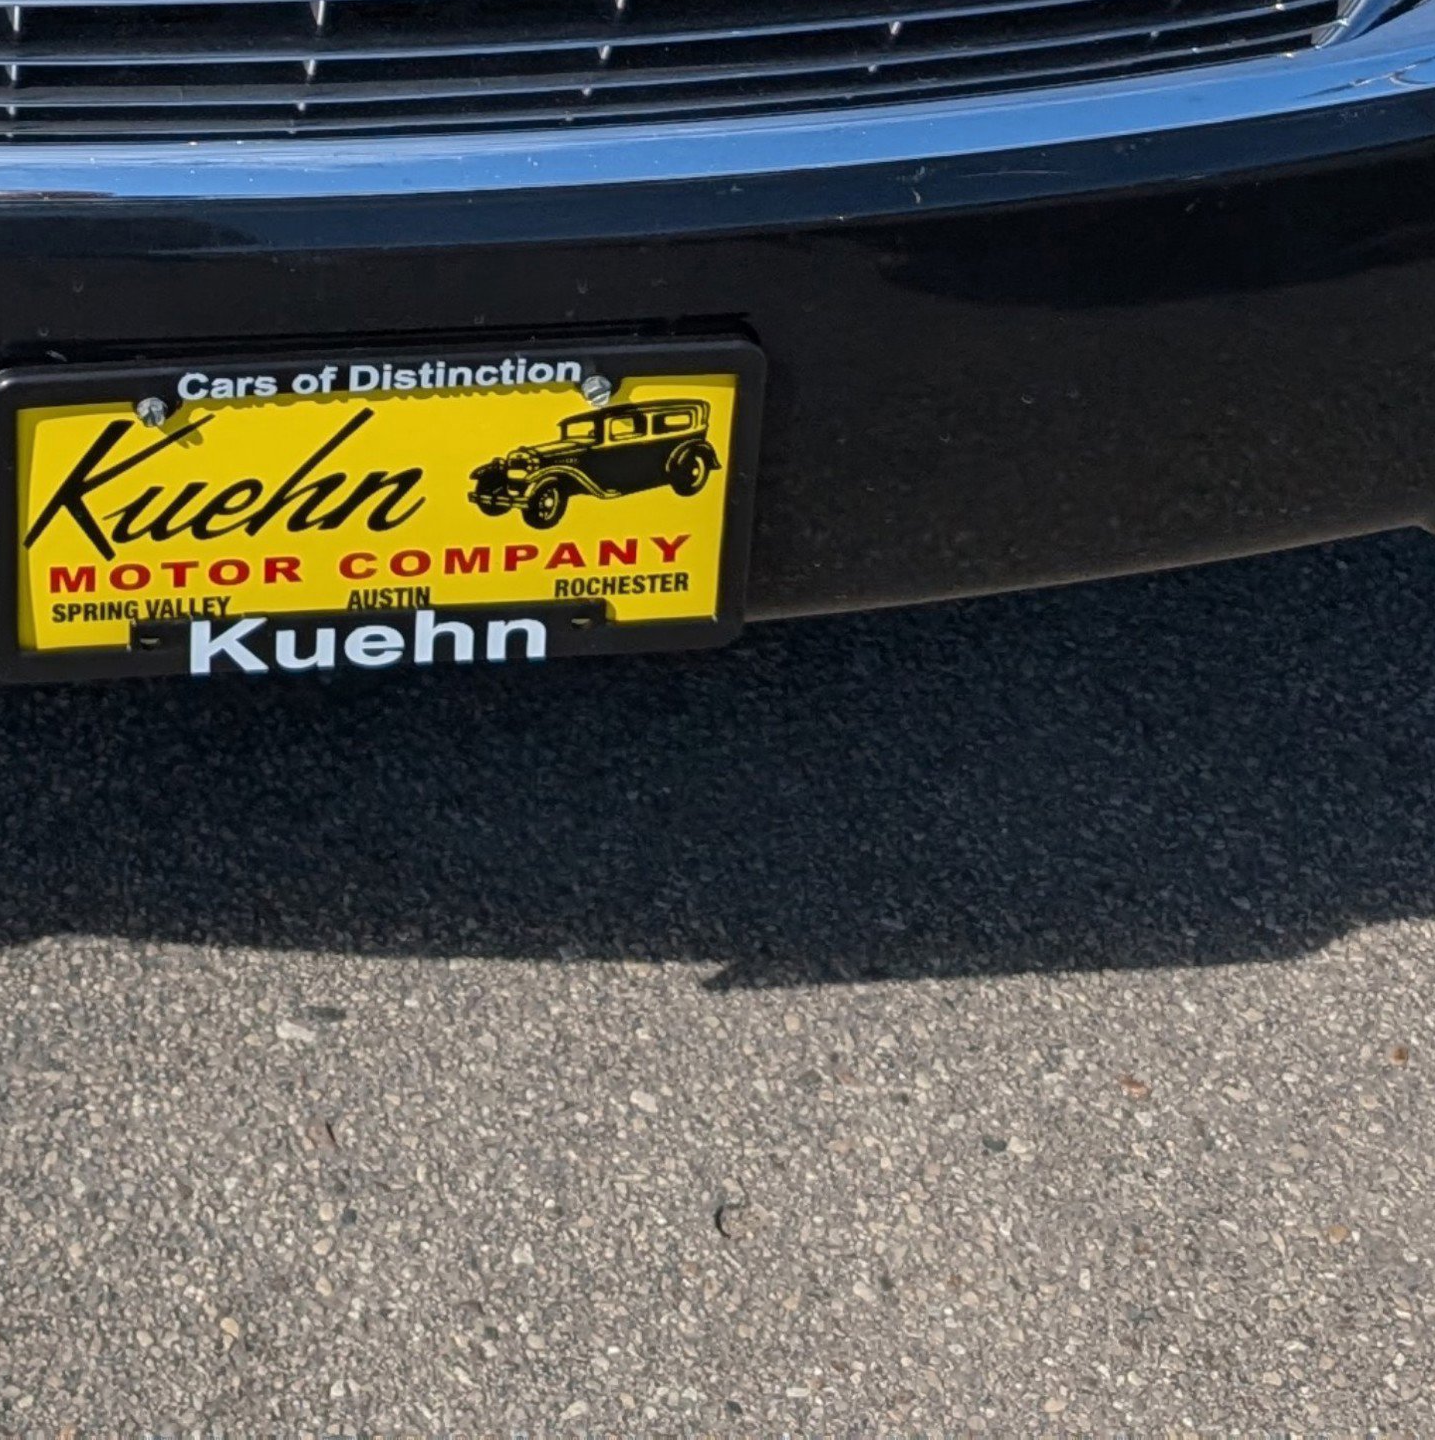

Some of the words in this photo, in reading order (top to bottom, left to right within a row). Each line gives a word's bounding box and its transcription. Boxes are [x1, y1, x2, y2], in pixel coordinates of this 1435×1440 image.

[177, 372, 278, 401] Cars
[289, 365, 338, 395] of
[350, 358, 582, 393] Distinction
[23, 407, 426, 561] Kuehn
[49, 556, 303, 594] MOTOR
[339, 534, 691, 580] COMPANY
[52, 599, 139, 623] SPRING
[144, 595, 231, 619] VALLEY
[347, 586, 432, 612] AUSTIN
[554, 572, 689, 598] ROCHESTER
[189, 610, 548, 675] Kuehn
